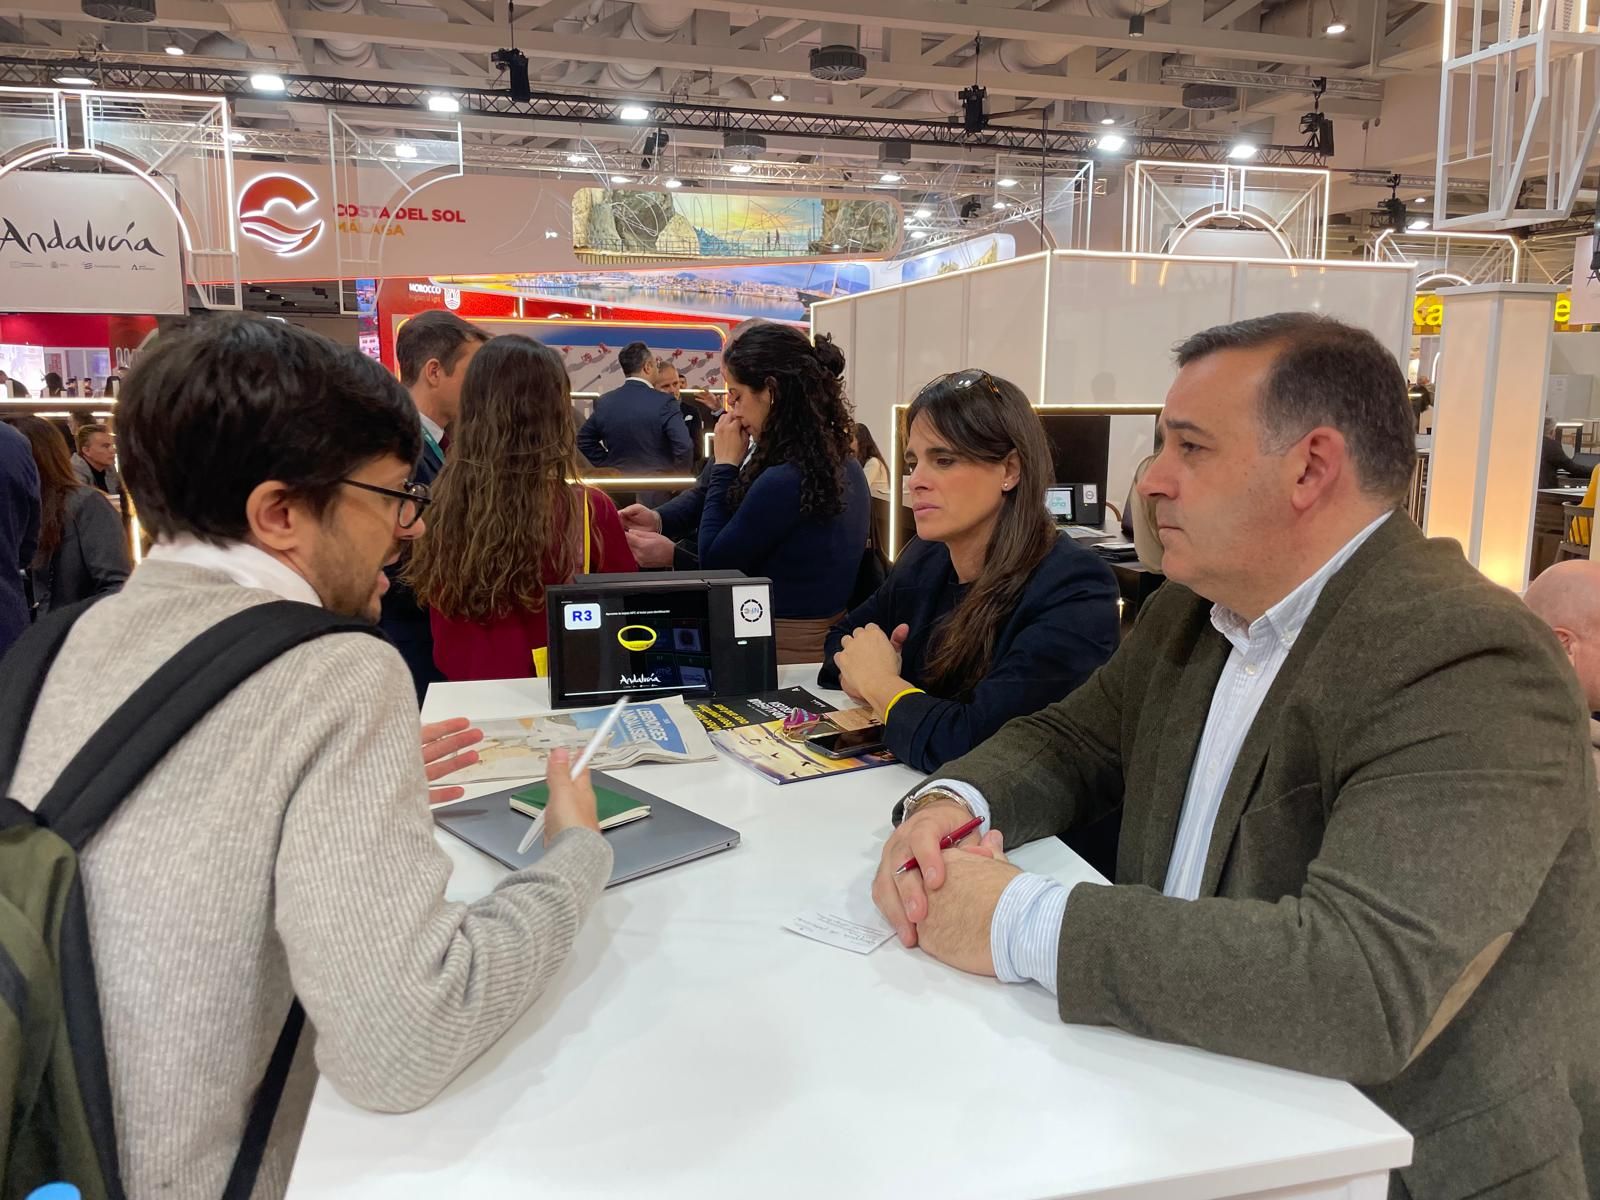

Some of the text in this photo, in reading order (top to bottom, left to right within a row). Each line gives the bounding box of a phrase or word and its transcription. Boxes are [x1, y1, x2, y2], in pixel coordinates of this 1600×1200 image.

[333, 203, 466, 223] COSTA DEL SOL
[0, 217, 165, 257] Andalucía
[408, 283, 442, 294] MOROCCO
[572, 610, 593, 622] R3
